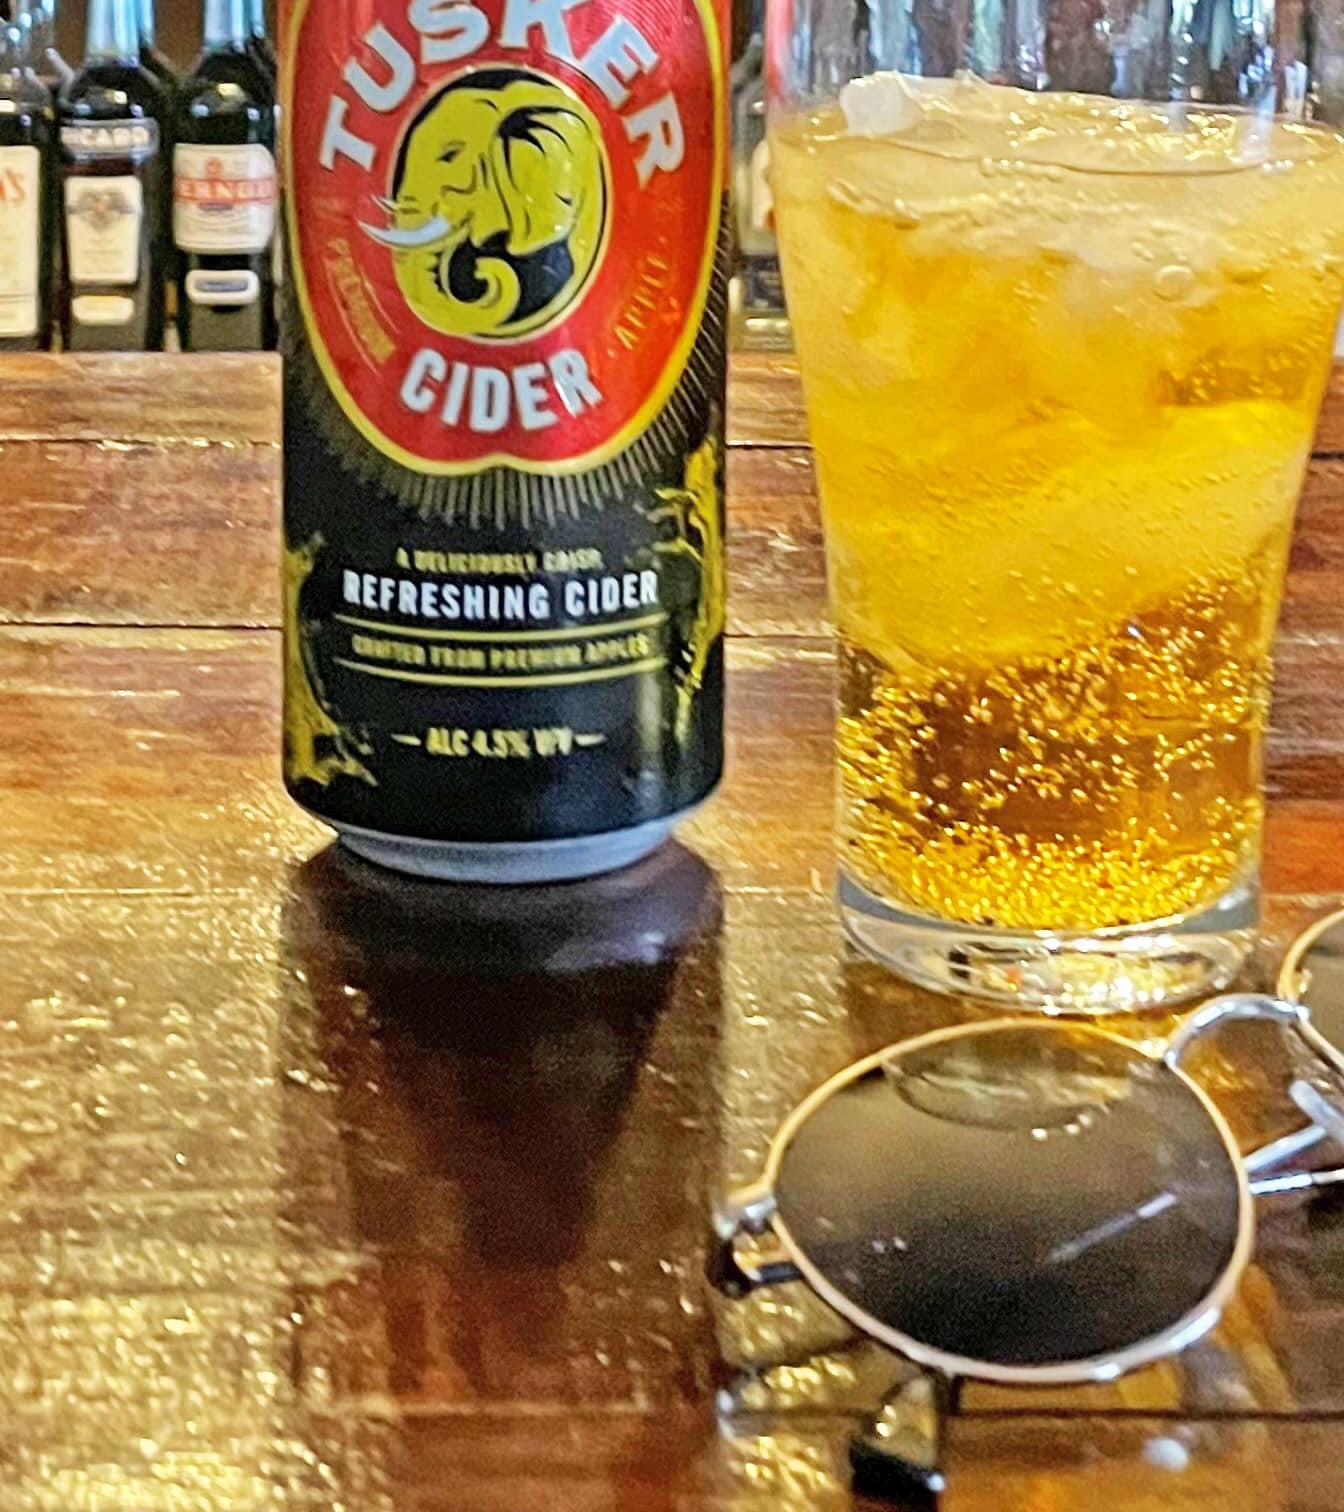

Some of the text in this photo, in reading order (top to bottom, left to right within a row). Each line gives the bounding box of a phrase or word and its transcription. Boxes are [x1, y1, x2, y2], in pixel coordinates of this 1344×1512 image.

[399, 347, 604, 433] CIDER
[343, 568, 659, 621] REFRESHING CIDER
[425, 726, 470, 758] ALC
